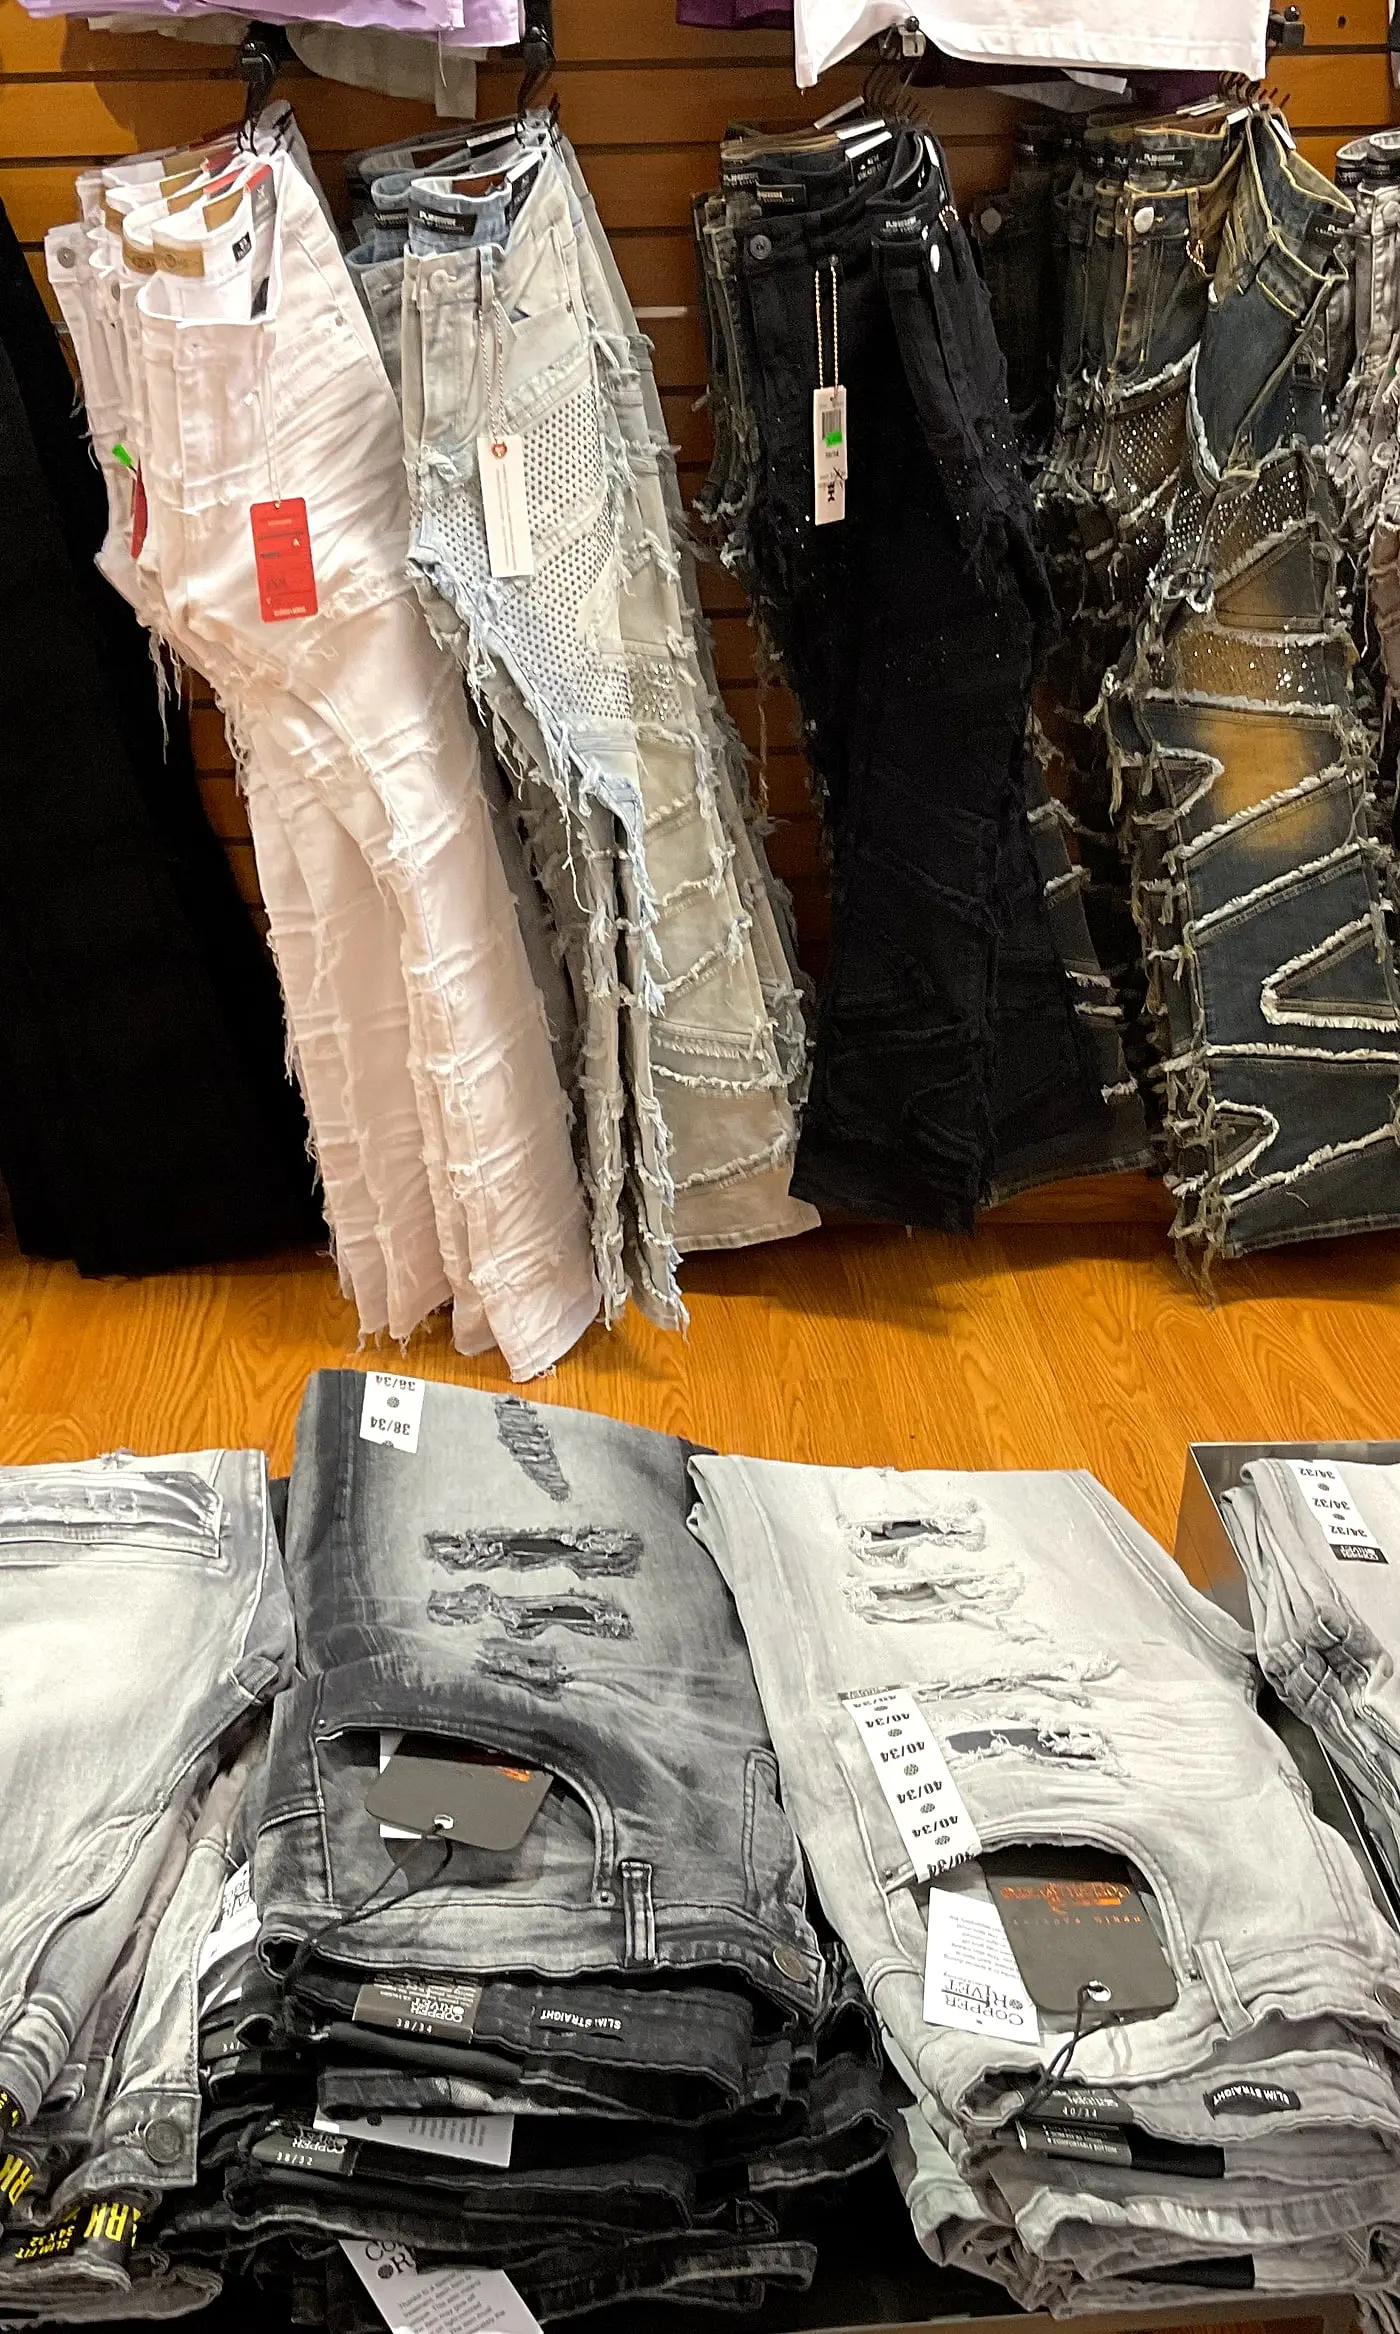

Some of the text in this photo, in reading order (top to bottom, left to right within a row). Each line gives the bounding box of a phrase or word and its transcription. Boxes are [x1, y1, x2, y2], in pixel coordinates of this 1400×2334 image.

[376, 1375, 416, 1391] 38/34
[370, 1416, 410, 1435] 38/34
[1298, 1467, 1335, 1479] 34/32
[1312, 1497, 1349, 1510] 34/32
[1328, 1525, 1367, 1537] 34/32
[865, 1713, 910, 1728] 40/34
[880, 1741, 924, 1762] 40/34
[896, 1780, 942, 1804] 40/34
[912, 1815, 958, 1837] 40/34
[944, 1978, 1007, 2009] RIVET
[539, 2009, 592, 2028] STRAIGHT
[944, 1995, 1024, 2026] COPPER
[396, 2018, 432, 2033] 38/34
[1212, 2085, 1262, 2104] STRAIGHT
[14, 2238, 70, 2259] SLIM FIT
